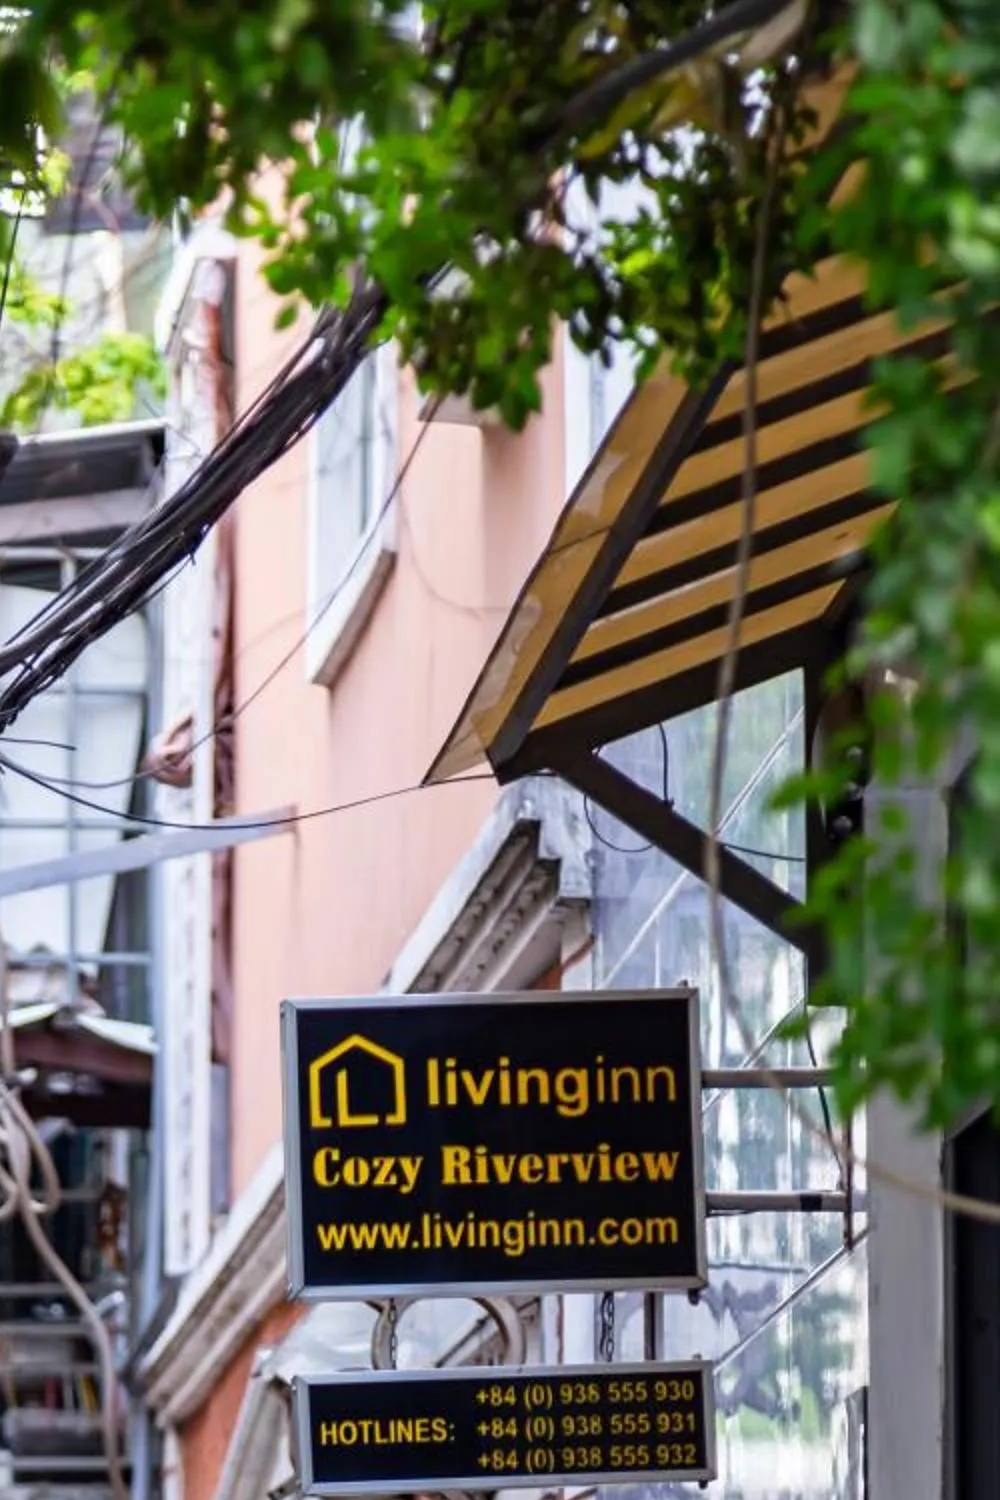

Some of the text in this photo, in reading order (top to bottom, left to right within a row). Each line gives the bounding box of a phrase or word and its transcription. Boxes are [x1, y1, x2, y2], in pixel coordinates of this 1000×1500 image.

[426, 1056, 677, 1117] livinginn
[312, 1143, 679, 1194] Cozy Riverview
[317, 1211, 679, 1257] www.livinginn.com
[475, 1385, 517, 1407] +84
[524, 1384, 553, 1411] (0)
[608, 1381, 648, 1401] 555
[655, 1380, 695, 1401] 930
[320, 1419, 456, 1446] HOTLINES:
[476, 1412, 696, 1442] +84 (0) 938 555 931
[477, 1444, 697, 1473] +84 (0) 938 555 932
